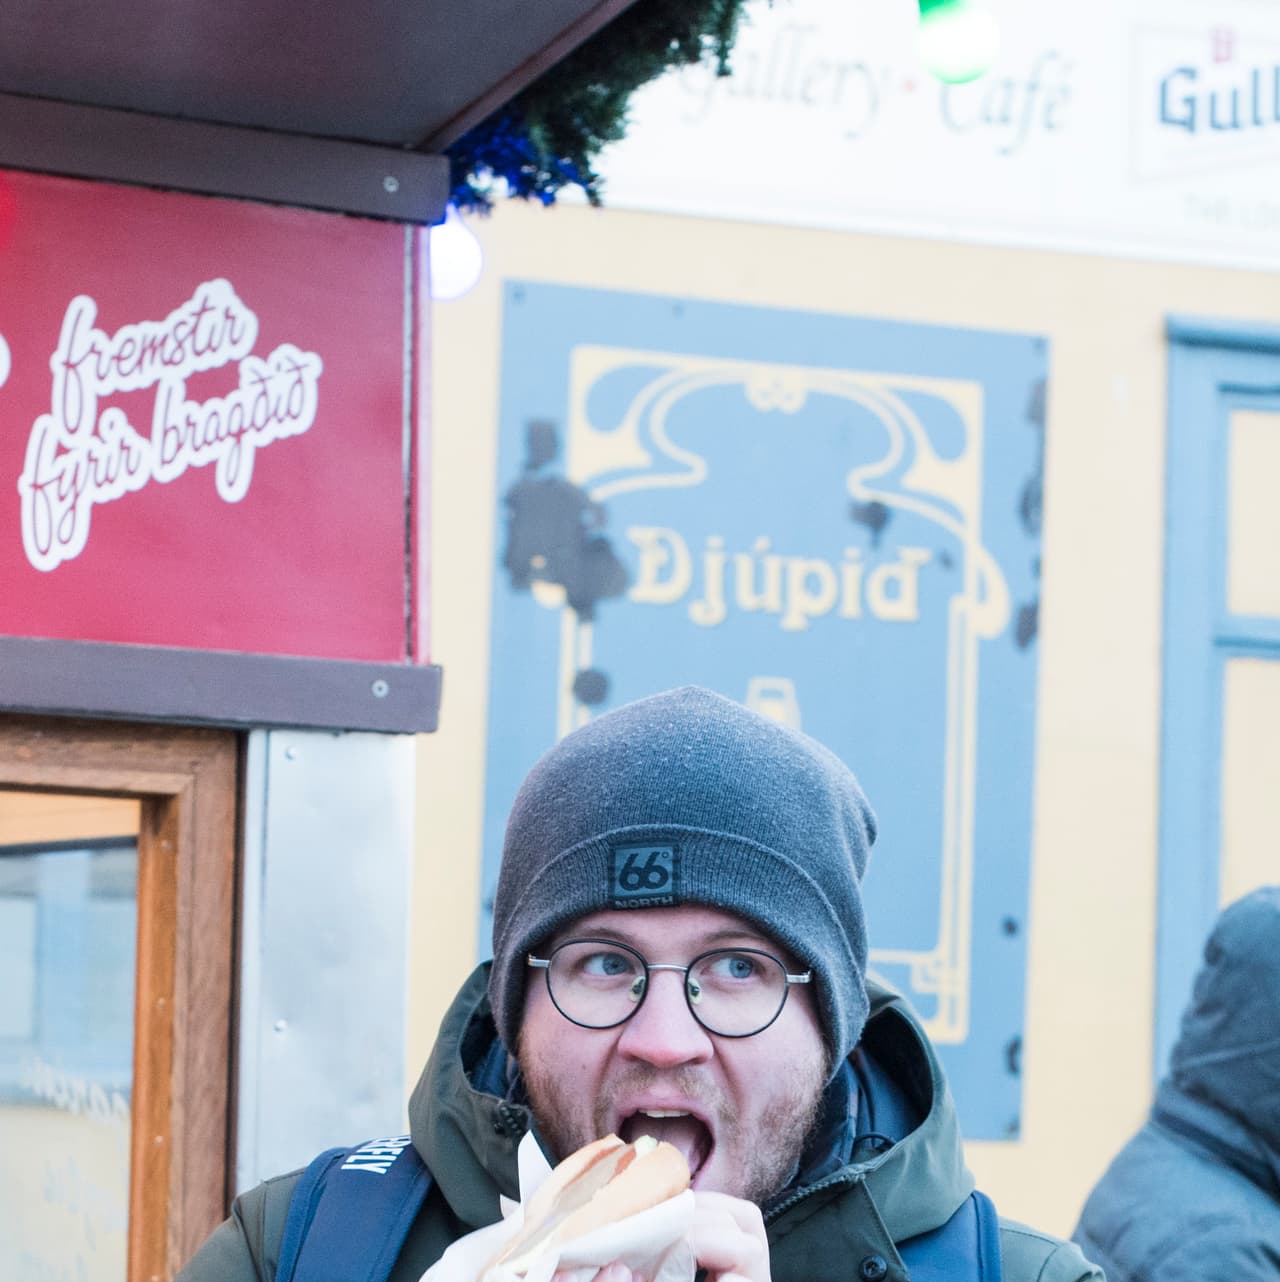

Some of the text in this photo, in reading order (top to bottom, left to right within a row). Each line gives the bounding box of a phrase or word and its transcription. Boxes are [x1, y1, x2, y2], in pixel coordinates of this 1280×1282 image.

[54, 287, 254, 442] fremstir
[22, 412, 148, 562] fyrir
[615, 896, 673, 909] NORTH
